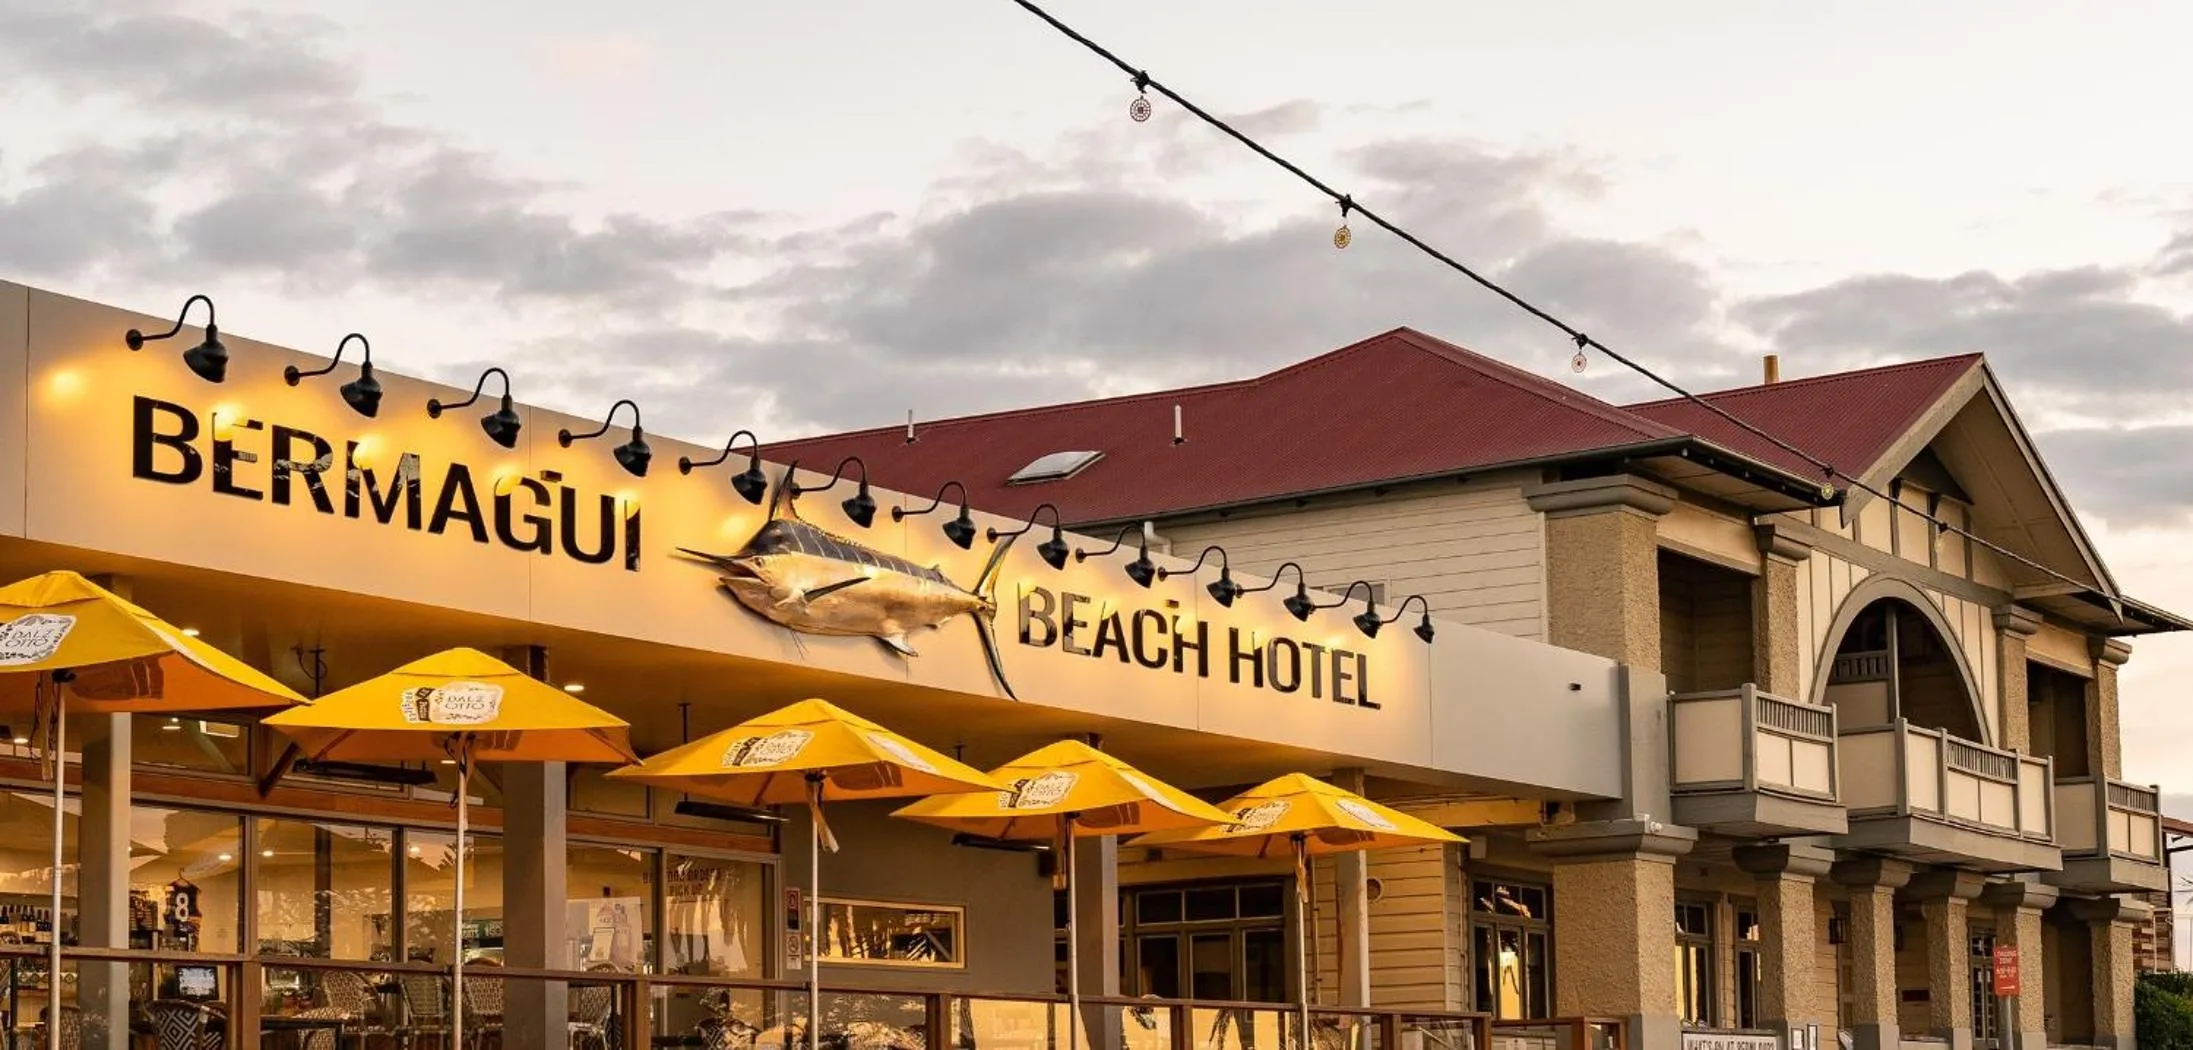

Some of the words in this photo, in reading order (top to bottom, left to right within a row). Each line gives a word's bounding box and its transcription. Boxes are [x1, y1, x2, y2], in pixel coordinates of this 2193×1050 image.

[133, 395, 641, 573] BERMAGUI
[1017, 582, 1209, 678] BEACH
[1228, 626, 1382, 711] HOTEL
[445, 702, 484, 710] OTTO
[175, 892, 189, 922] 8
